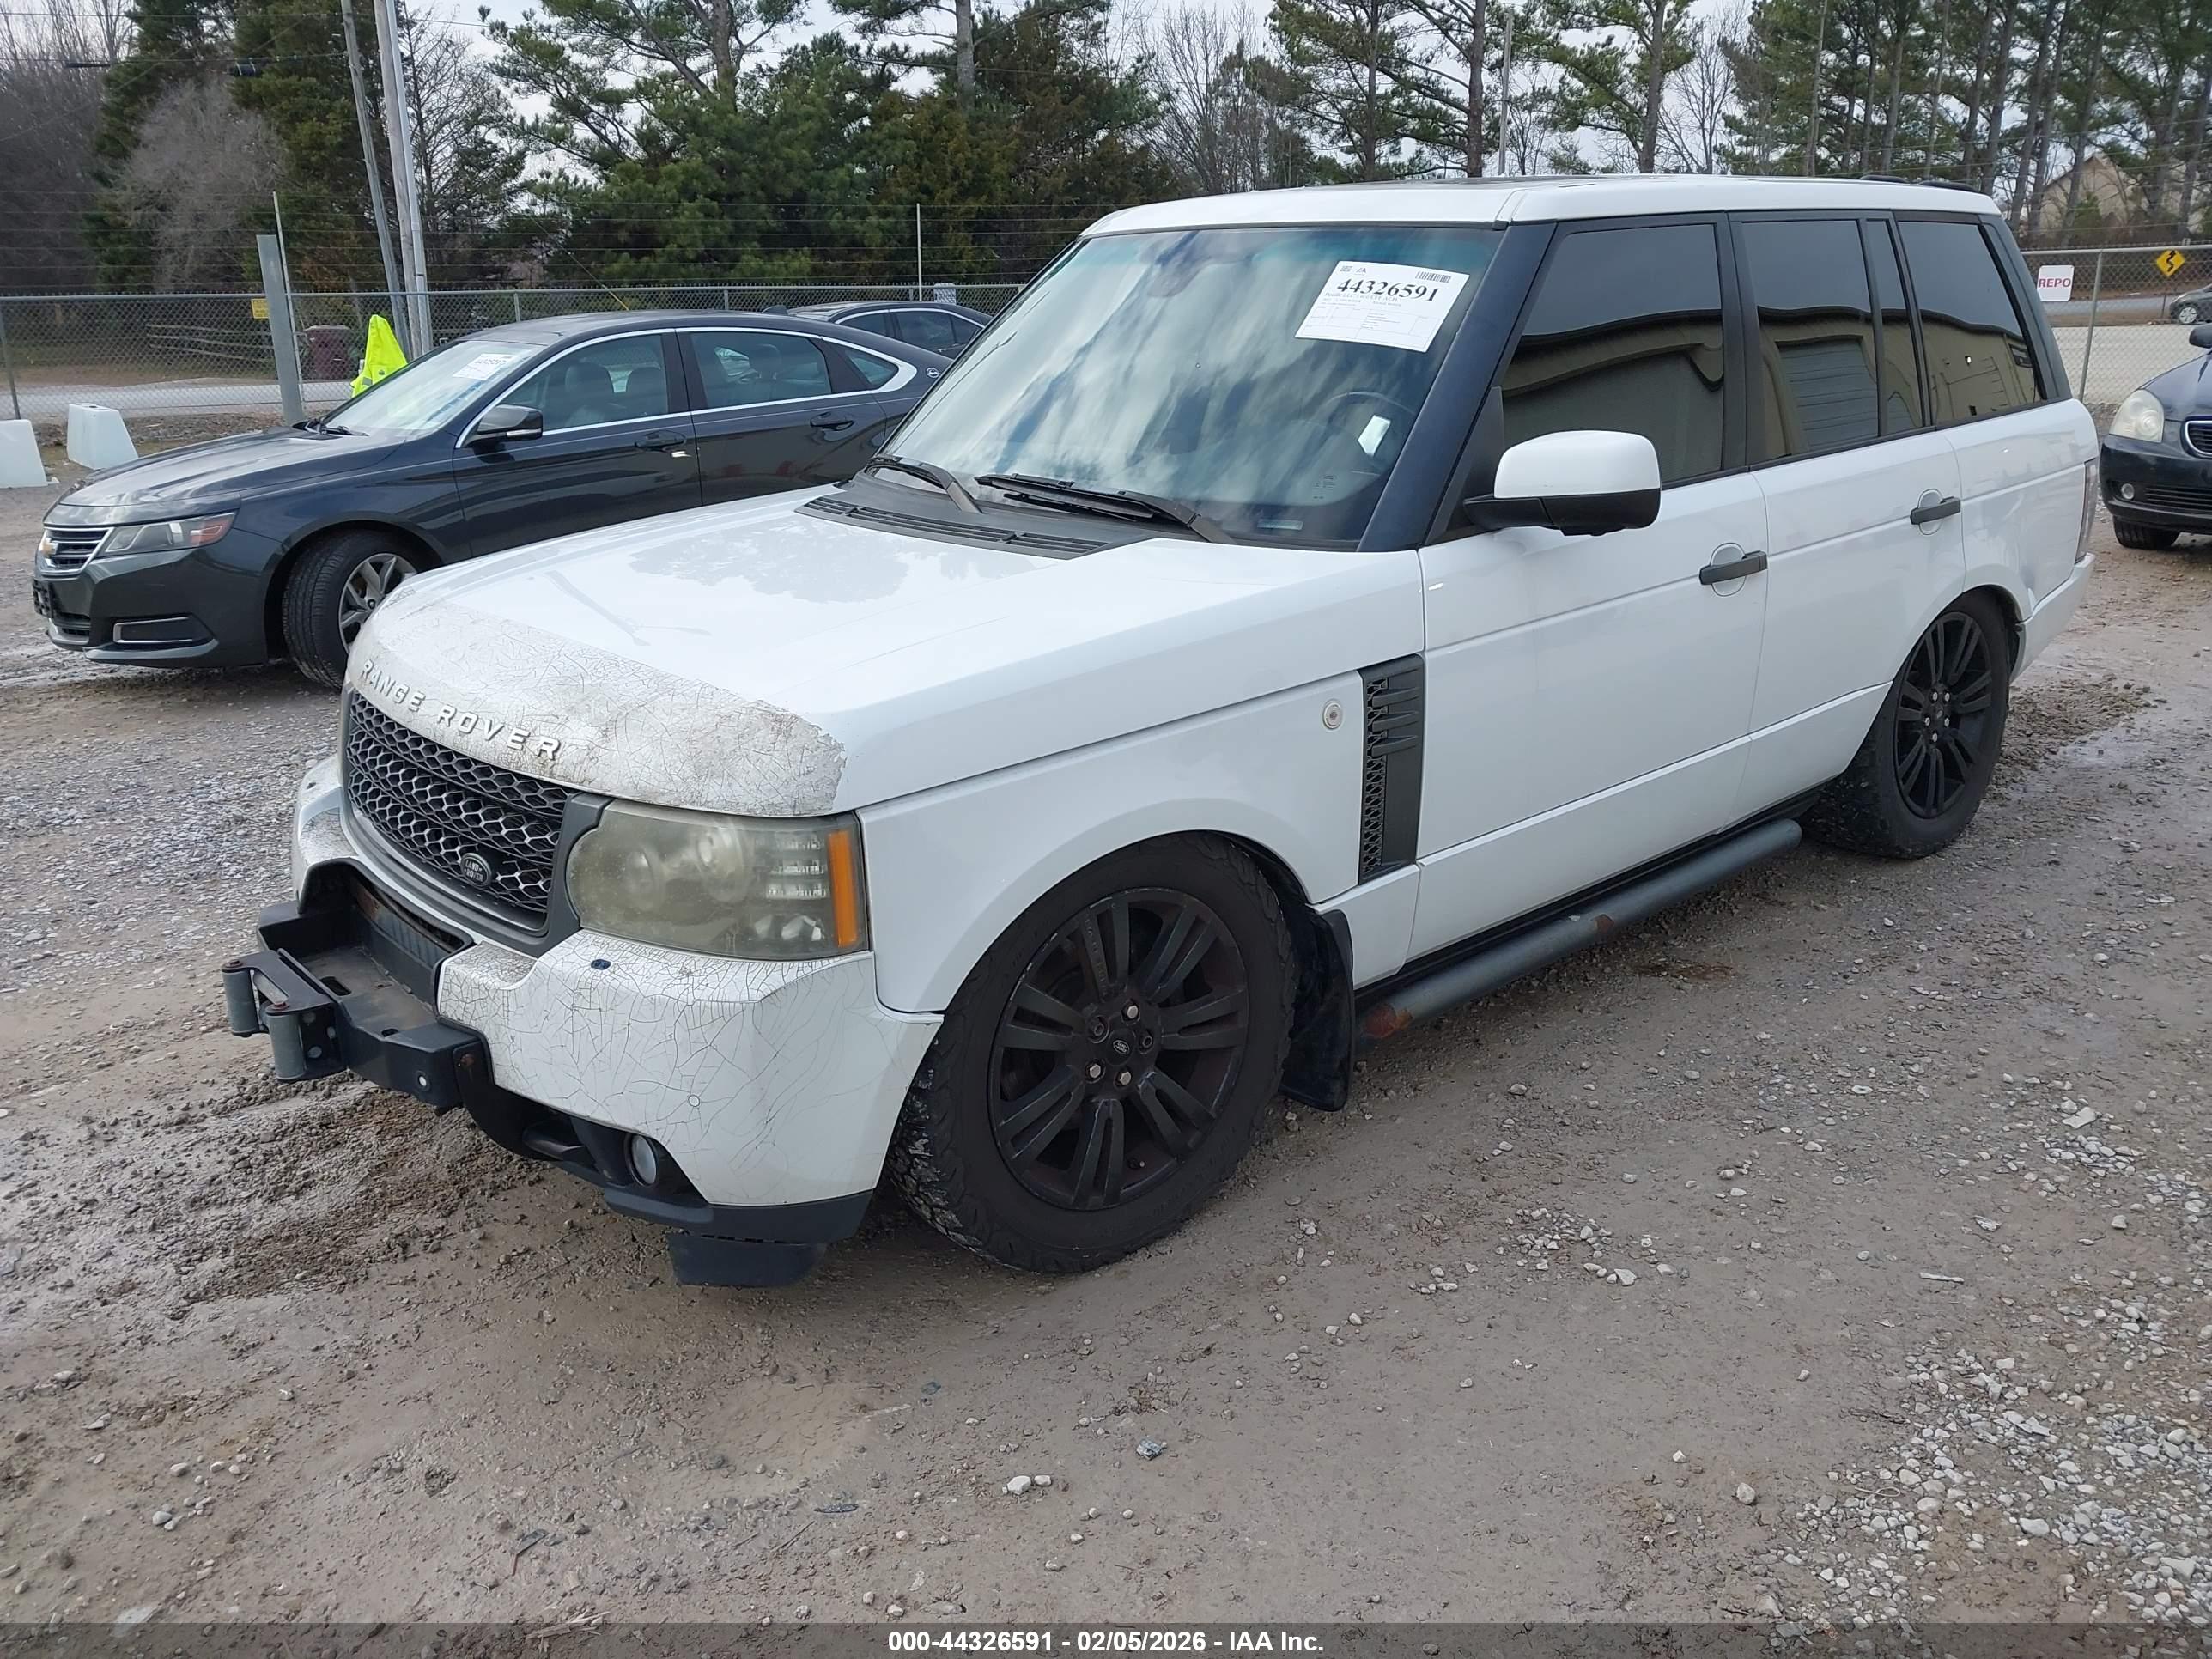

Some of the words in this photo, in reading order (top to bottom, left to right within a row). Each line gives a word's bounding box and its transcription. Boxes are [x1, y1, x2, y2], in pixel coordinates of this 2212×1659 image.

[1337, 278, 1440, 301] 44326591
[2038, 277, 2071, 289] REPO
[359, 659, 426, 712] RANGE
[436, 704, 562, 761] ROVER
[465, 860, 479, 872] LAND
[466, 868, 483, 882] ROVER
